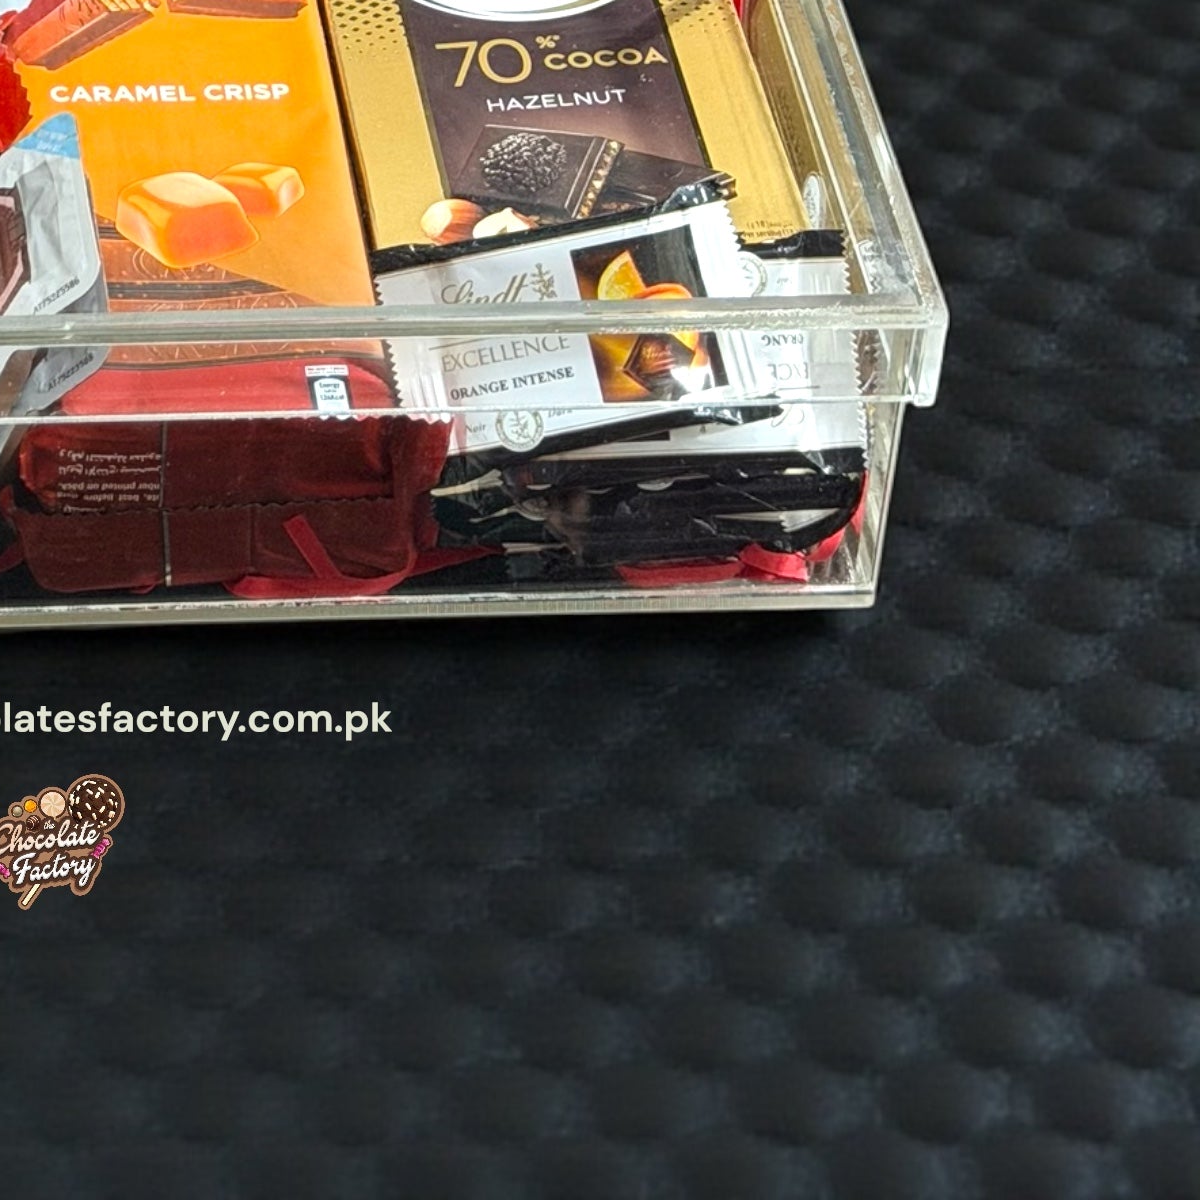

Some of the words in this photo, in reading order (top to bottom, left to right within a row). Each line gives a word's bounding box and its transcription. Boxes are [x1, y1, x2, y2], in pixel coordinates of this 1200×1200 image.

[543, 46, 669, 70] COCOA
[49, 85, 197, 103] CARAMEL
[203, 83, 291, 100] CRISP
[486, 88, 627, 113] HAZELNUT
[441, 335, 571, 373] EXCELLENCE
[450, 380, 510, 401] ORANGE
[513, 366, 575, 389] INTENSE
